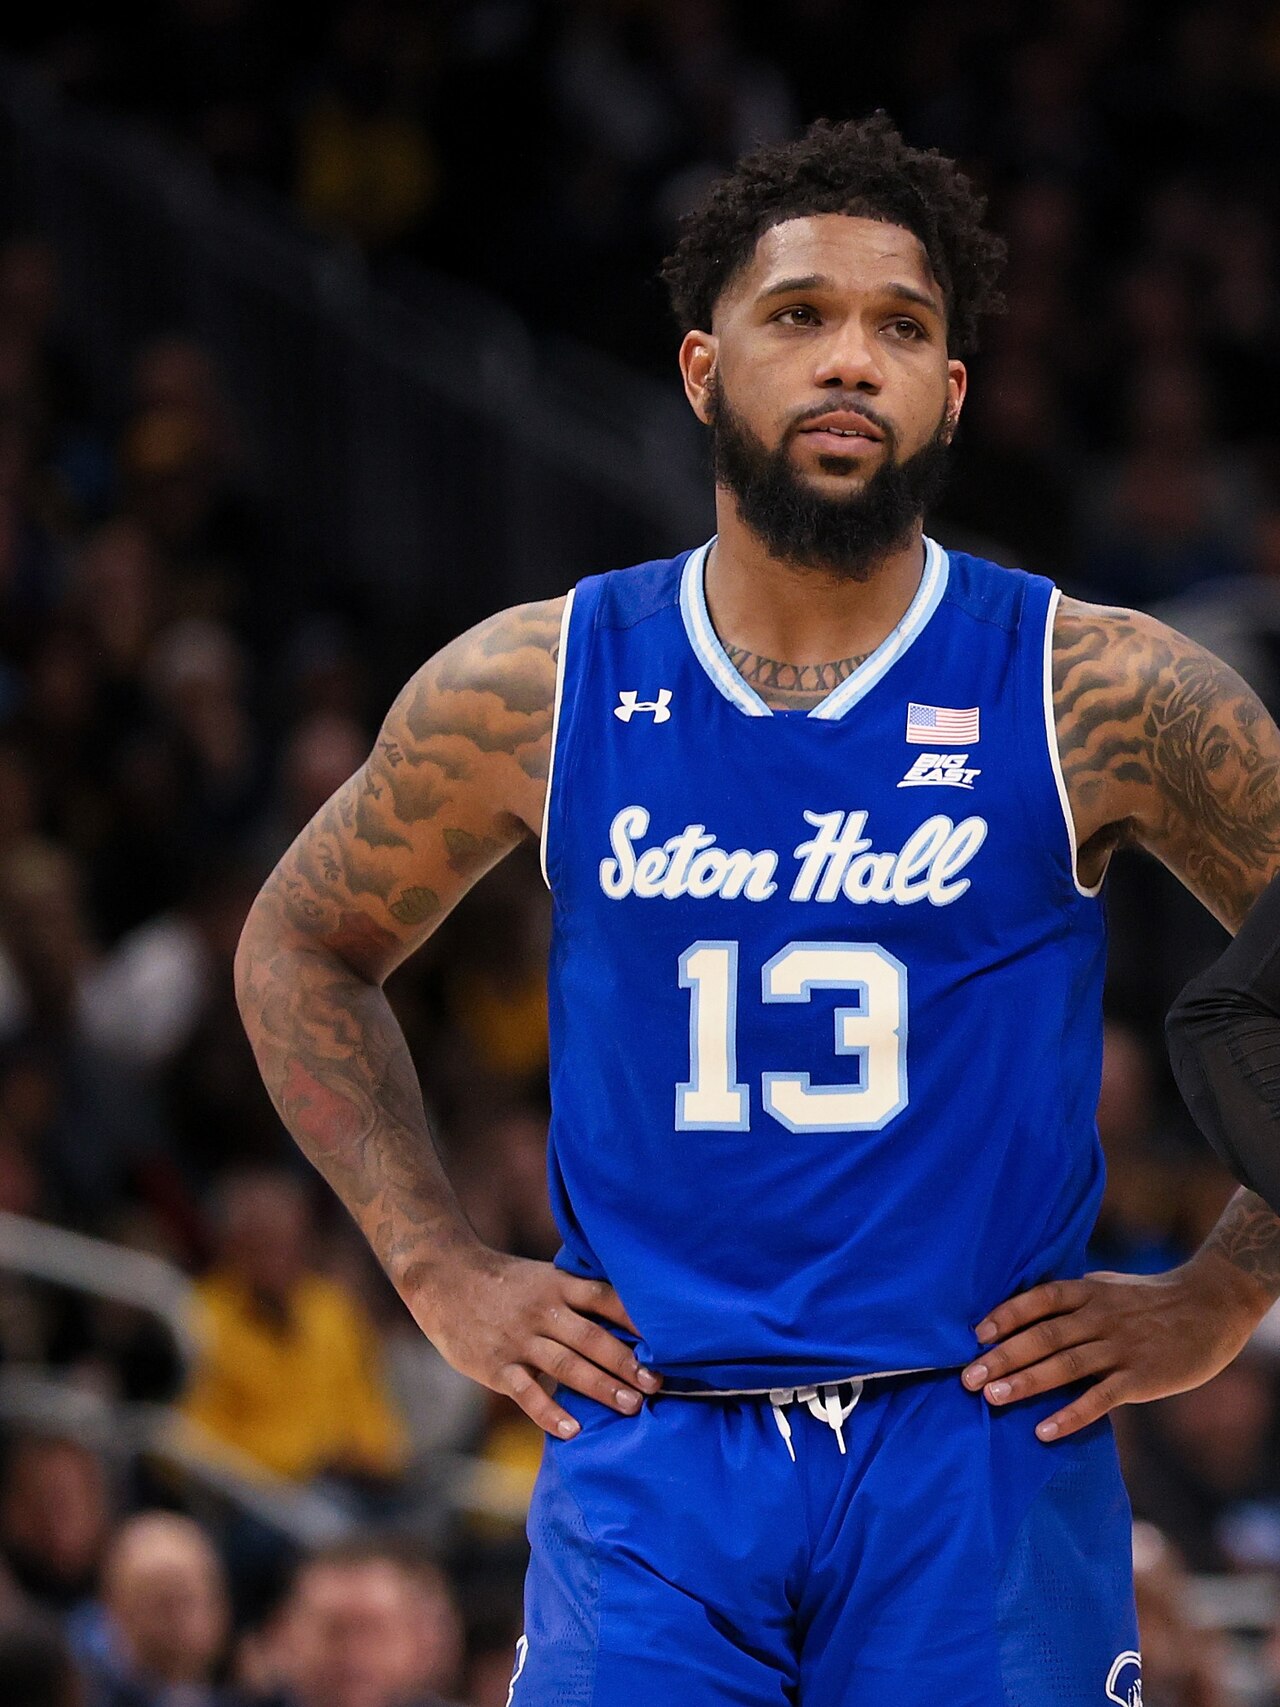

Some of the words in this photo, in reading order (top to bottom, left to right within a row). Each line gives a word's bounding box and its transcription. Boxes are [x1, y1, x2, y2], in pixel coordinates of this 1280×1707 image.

[903, 767, 981, 784] EAST
[913, 753, 969, 769] BIG
[600, 805, 778, 900] Seton
[789, 811, 988, 906] Hall
[675, 940, 909, 1133] 13
